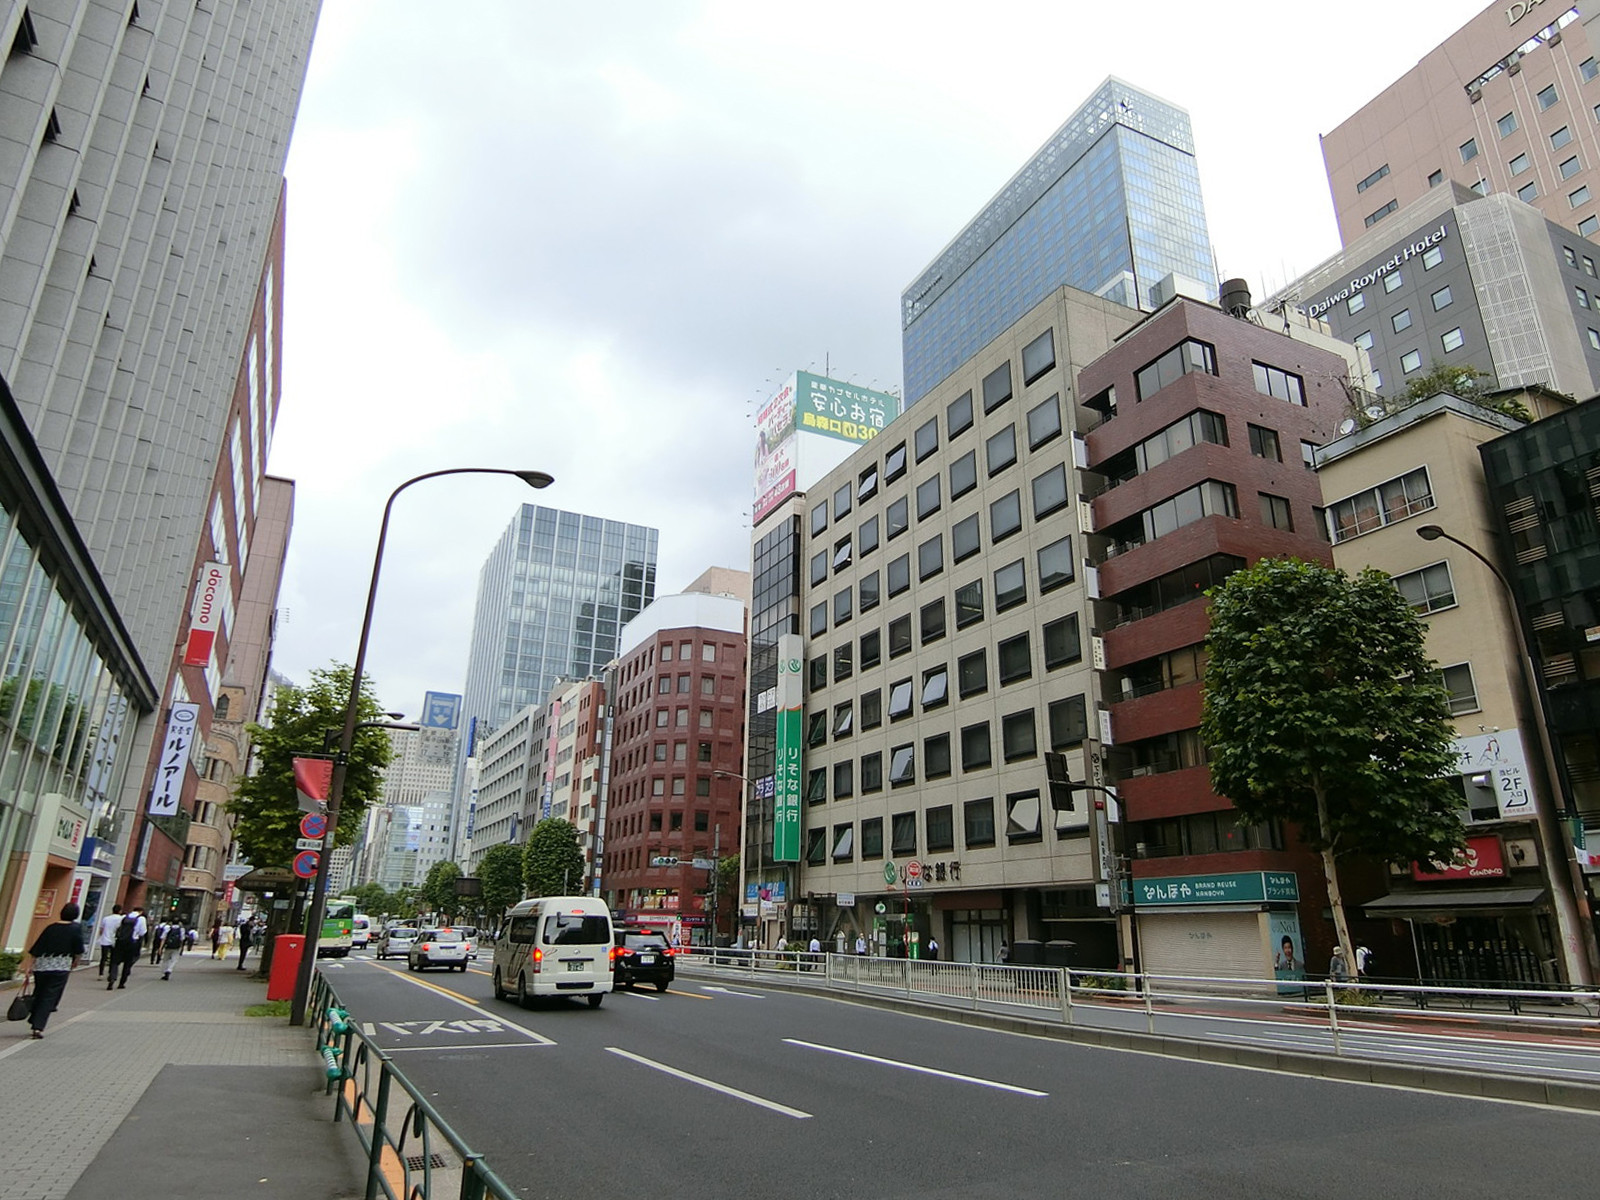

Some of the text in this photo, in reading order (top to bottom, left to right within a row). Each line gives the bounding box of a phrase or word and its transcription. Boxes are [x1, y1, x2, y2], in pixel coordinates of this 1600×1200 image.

[1308, 225, 1447, 318] Daiwa Roynet Hotel
[811, 392, 885, 428] 安心お宿
[199, 568, 223, 624] docomo
[156, 737, 186, 808] ルノアール
[786, 747, 798, 823] りそな銀行
[1501, 777, 1522, 791] 2F
[899, 861, 962, 883] りな銀行
[1194, 880, 1237, 890] BRAND REUSE
[1143, 883, 1192, 900] なんぼや
[1195, 890, 1225, 898] NANBOYA
